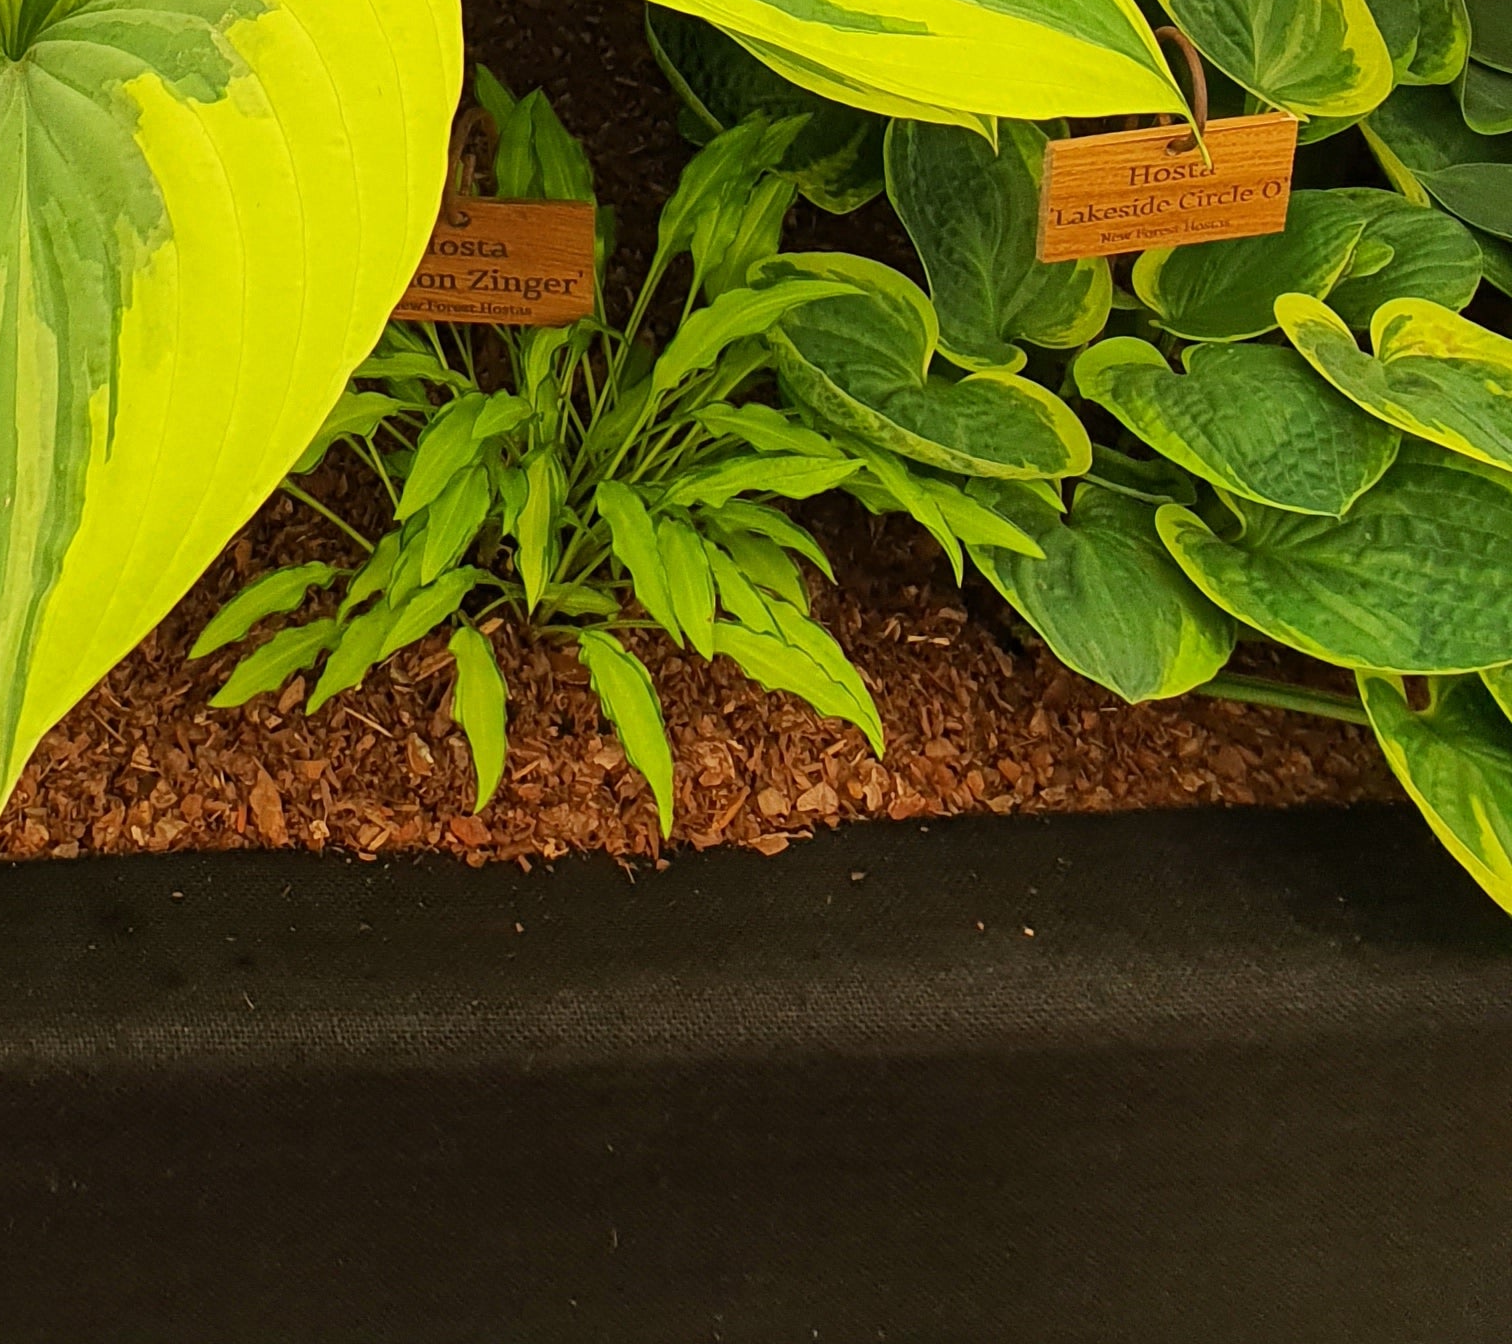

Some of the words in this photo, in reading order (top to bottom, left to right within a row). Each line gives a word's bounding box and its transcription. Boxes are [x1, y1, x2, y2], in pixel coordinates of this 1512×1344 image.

[1128, 162, 1217, 186] Hosta
[1050, 195, 1172, 227] 'Lakeside
[1179, 184, 1254, 210] Circle
[1101, 230, 1131, 244] New
[1136, 224, 1180, 239] Forest
[1183, 218, 1232, 233] Hostas
[467, 268, 584, 301] Zinger'
[480, 301, 532, 315] Hostas
